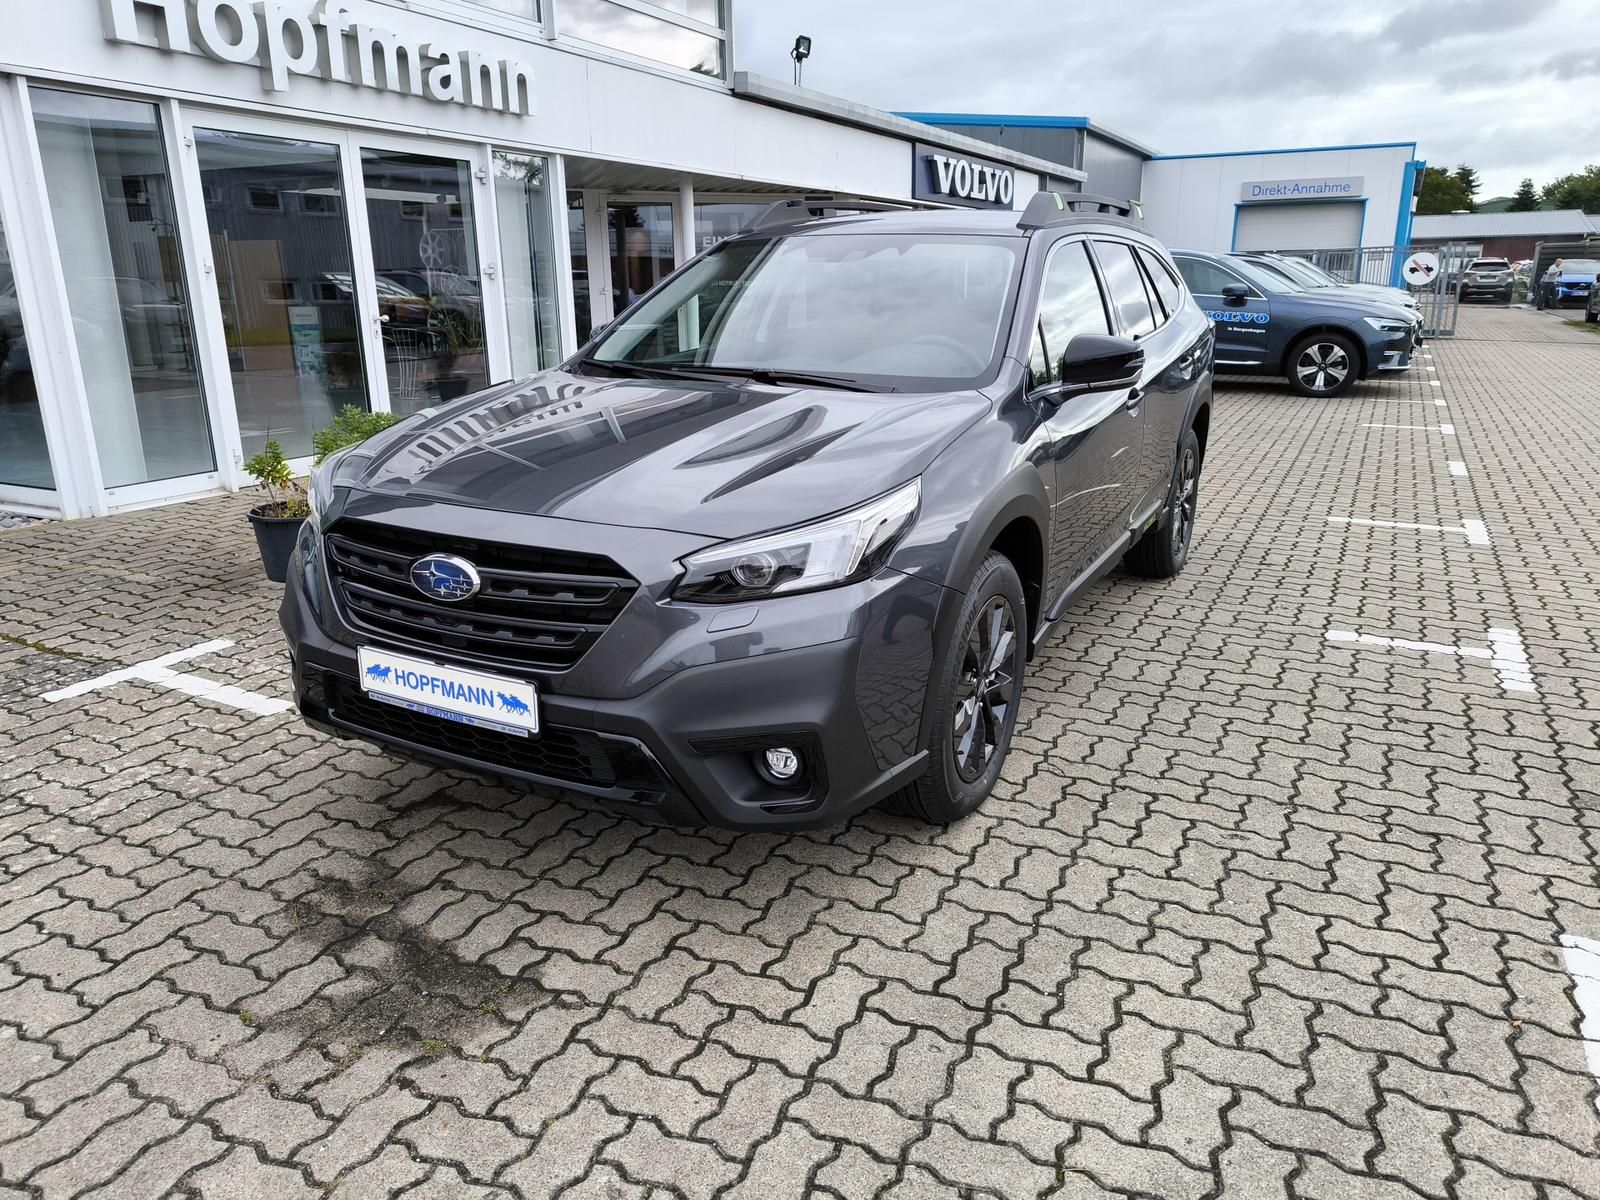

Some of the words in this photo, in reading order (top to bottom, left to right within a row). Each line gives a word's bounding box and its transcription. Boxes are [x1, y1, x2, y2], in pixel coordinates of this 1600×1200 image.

[104, 0, 536, 116] Hopfmann
[933, 153, 1013, 204] VOLVO
[1251, 181, 1351, 197] Direkt-Annahme
[394, 668, 494, 708] HOPFMANN
